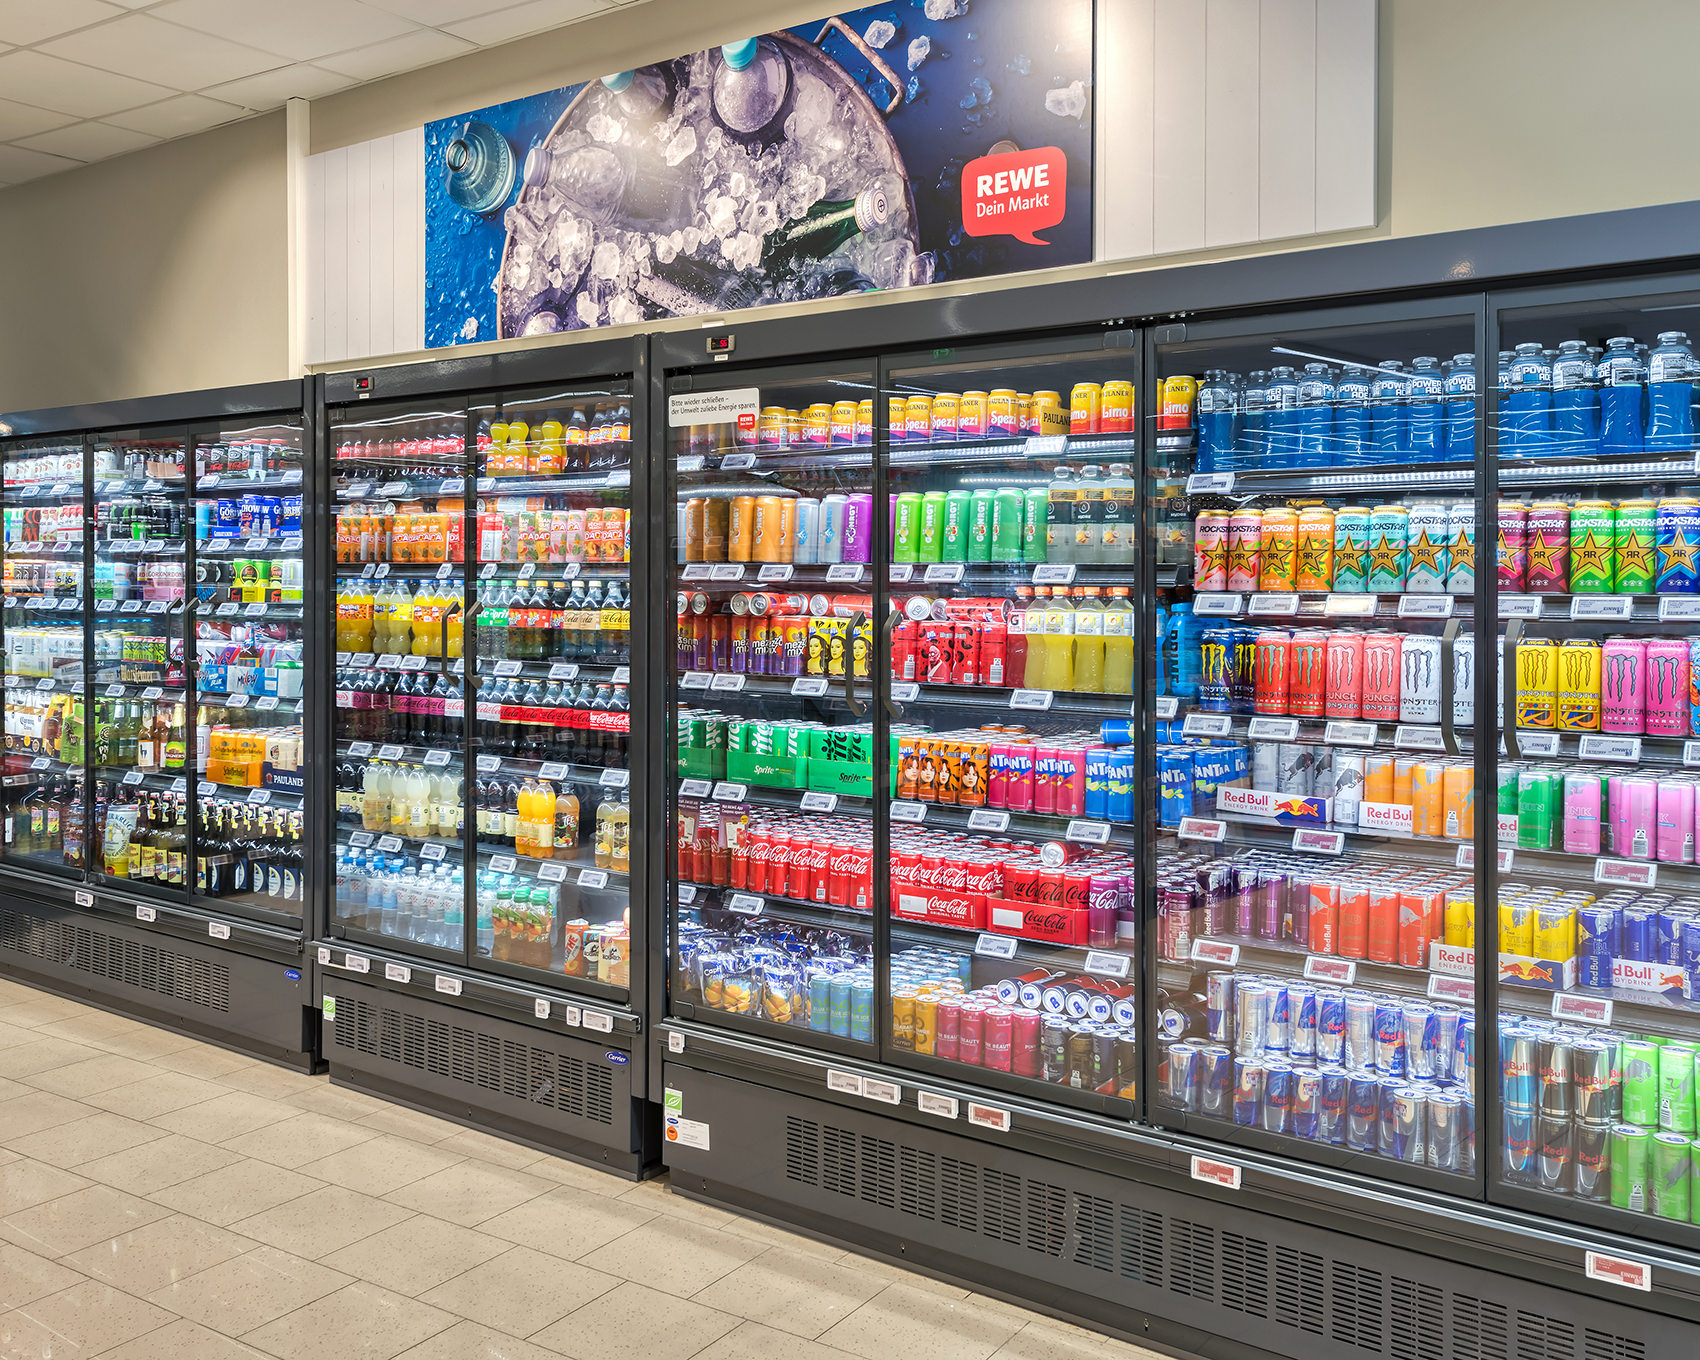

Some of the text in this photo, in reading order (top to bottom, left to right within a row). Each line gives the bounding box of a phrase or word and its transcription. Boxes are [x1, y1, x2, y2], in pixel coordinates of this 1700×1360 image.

[977, 164, 1049, 198] REWE
[976, 193, 1050, 218] Dein Markt
[1339, 384, 1369, 393] POWER
[1382, 381, 1406, 390] POWE
[1413, 380, 1442, 389] POWER
[671, 399, 683, 407] Bitte
[684, 398, 700, 406] wieder
[701, 395, 724, 404] schließen
[680, 406, 699, 415] Umwelt
[718, 403, 737, 412] Energie
[738, 402, 757, 410] sparen.
[1102, 405, 1128, 418] Limo
[1164, 402, 1189, 414] Limo
[990, 410, 1017, 425] Spezi
[1363, 694, 1397, 703] PUNCH
[754, 764, 775, 775] Sprite
[839, 772, 861, 783] Sprite
[1224, 790, 1268, 806] Red Bull
[1224, 802, 1248, 810] ENERGY
[1367, 807, 1412, 821] Red Bul
[927, 896, 970, 915] Coca-Cola
[1023, 910, 1069, 930] Coca-Cola
[1324, 924, 1332, 953] Red Bull
[1438, 949, 1464, 963] Red
[1438, 962, 1465, 971] ENERGY
[1590, 956, 1599, 987] Red Bull
[1624, 965, 1652, 980] Bull
[608, 1053, 626, 1062] Carrier
[1510, 1062, 1529, 1072] Bull
[1547, 1067, 1567, 1078] Bull
[1507, 1136, 1526, 1148] Red
[1543, 1144, 1563, 1156] Red
[1579, 1152, 1598, 1164] Red
